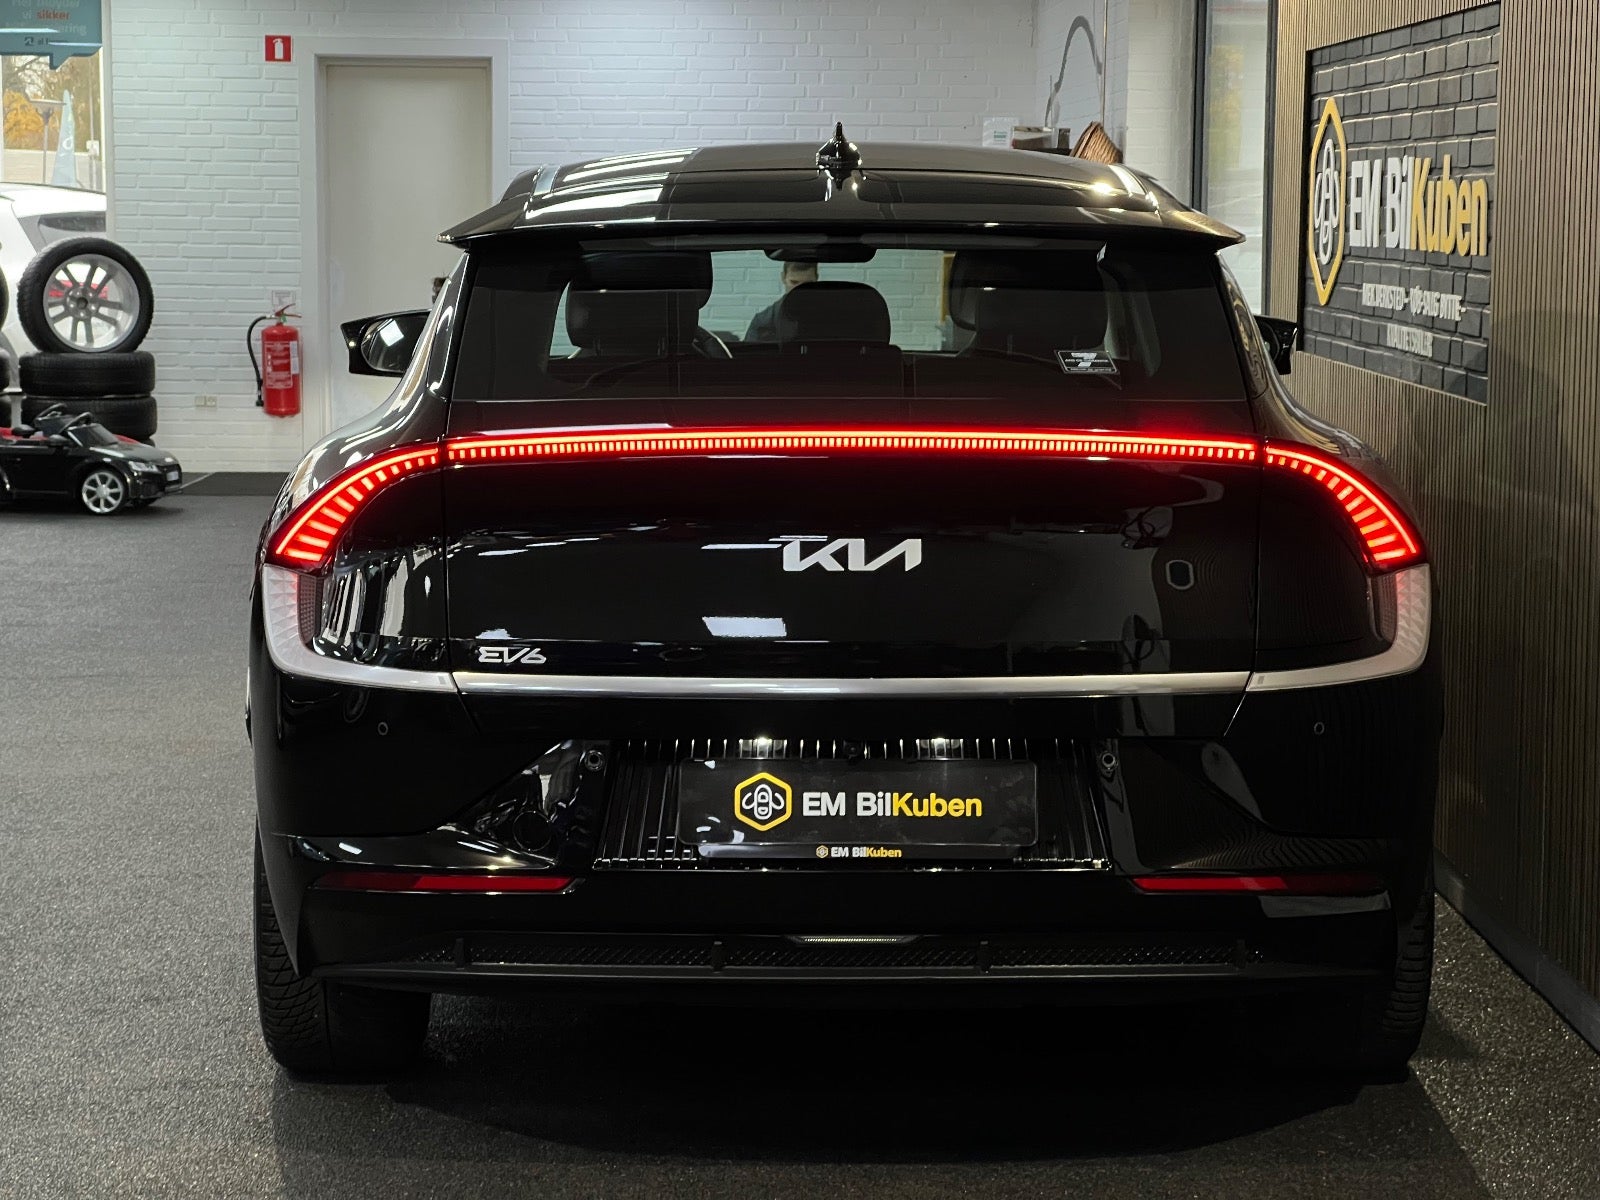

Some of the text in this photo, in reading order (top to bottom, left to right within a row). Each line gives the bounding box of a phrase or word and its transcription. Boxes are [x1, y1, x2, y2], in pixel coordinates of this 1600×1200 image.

[36, 9, 70, 20] sikker
[1349, 154, 1488, 257] EM BilKuben
[783, 538, 922, 572] KIA
[478, 646, 547, 664] EV6
[802, 791, 982, 818] EM BilKuben
[830, 845, 902, 858] EM BilKuben
